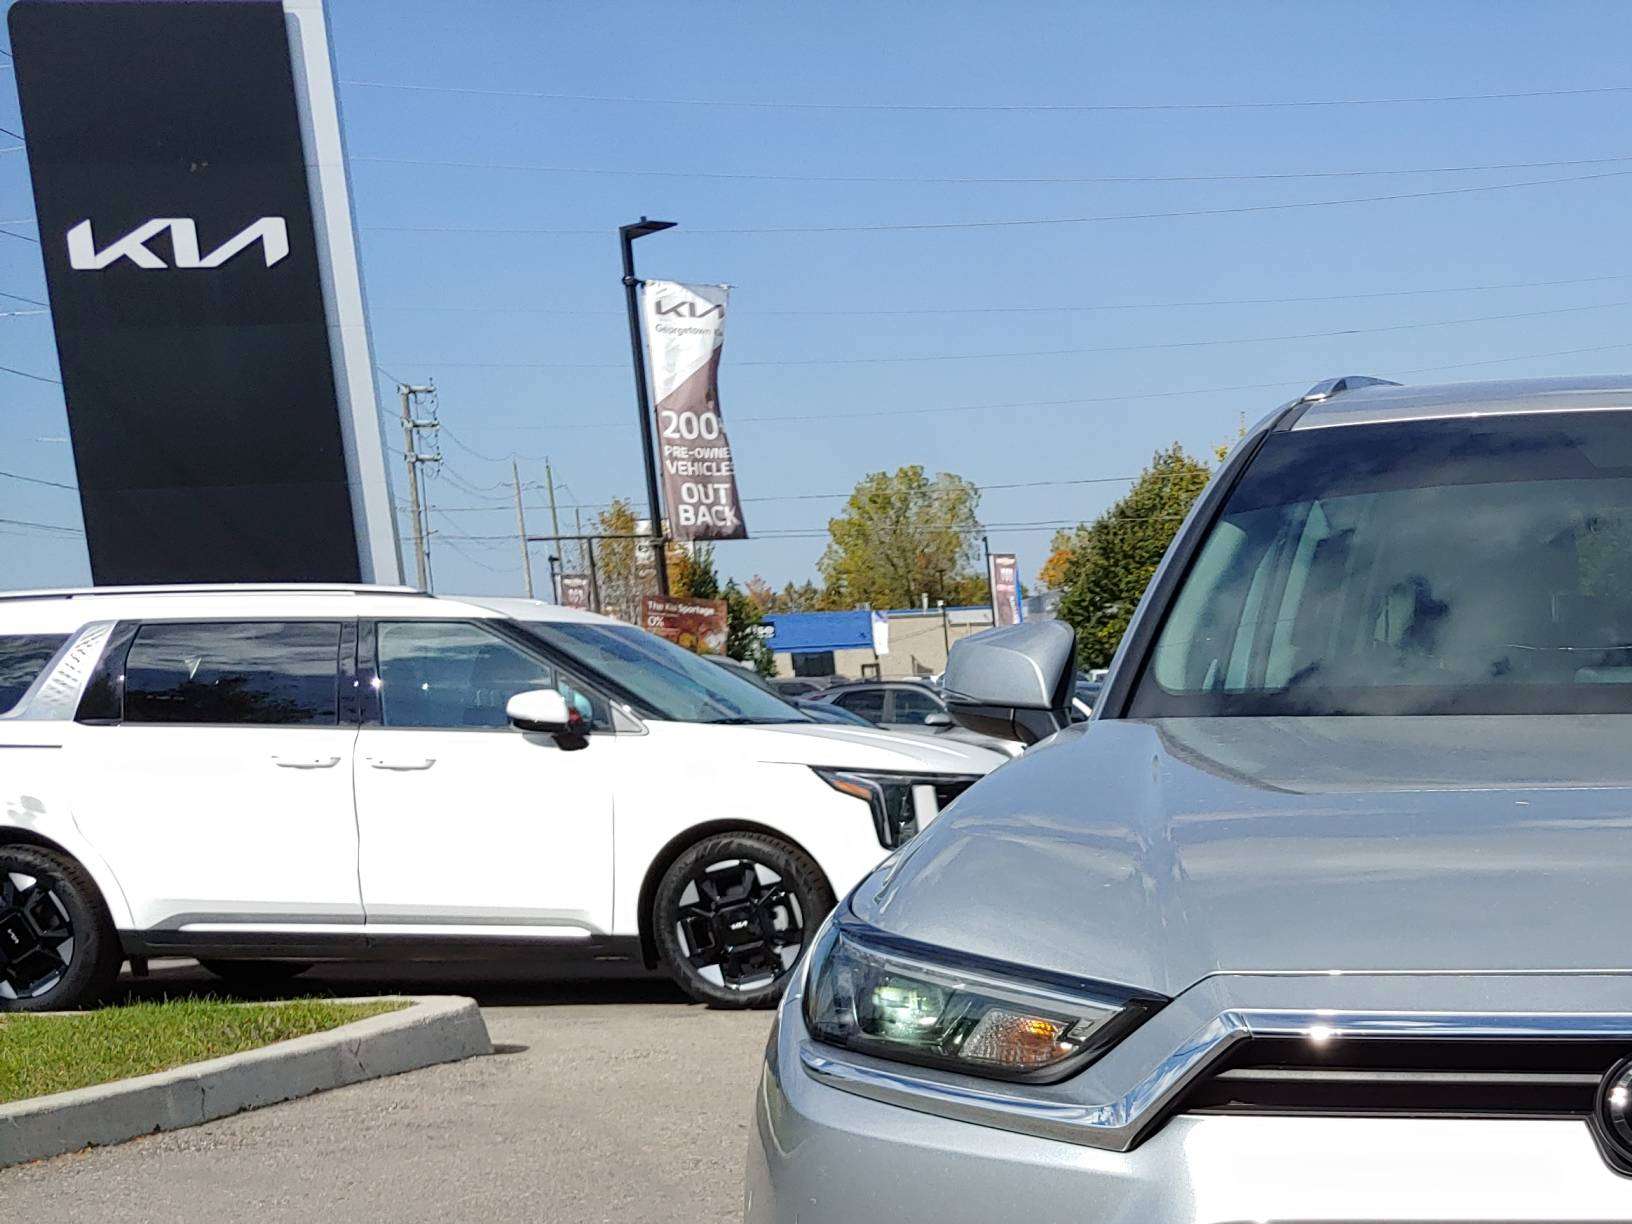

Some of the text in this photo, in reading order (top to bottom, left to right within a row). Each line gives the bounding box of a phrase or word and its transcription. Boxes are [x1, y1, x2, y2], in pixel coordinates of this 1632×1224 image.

[66, 217, 289, 269] KIA
[655, 300, 725, 320] KIA
[664, 445, 730, 459] PRE-OWNE
[680, 482, 731, 505] OUT
[678, 504, 741, 527] BACK
